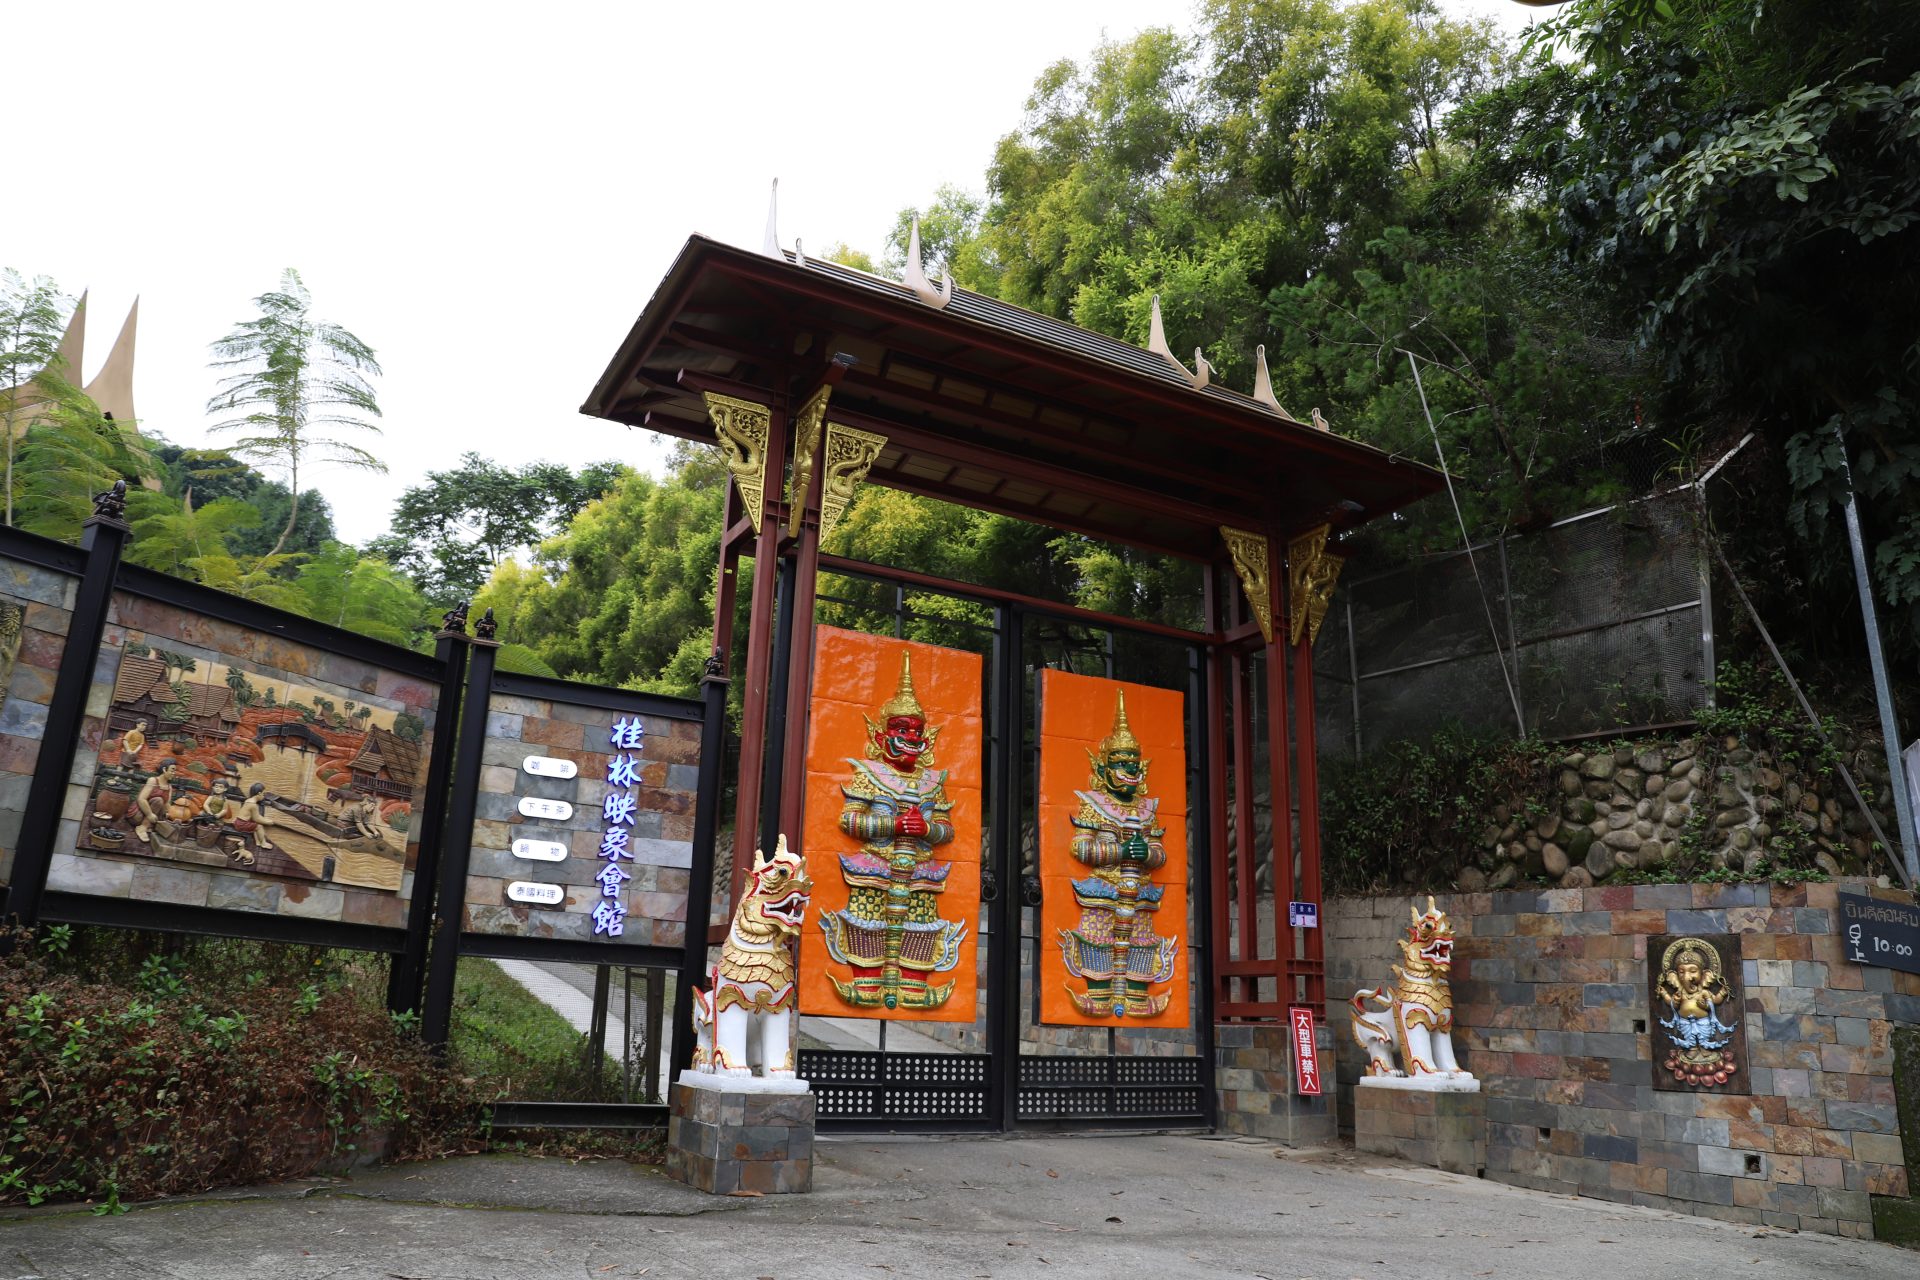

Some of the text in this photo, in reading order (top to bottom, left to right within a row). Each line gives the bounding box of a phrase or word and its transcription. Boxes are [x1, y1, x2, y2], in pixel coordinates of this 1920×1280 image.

[527, 802, 565, 815] 下午茶
[592, 716, 644, 937] 桂林映象會館
[516, 886, 556, 900] 泰國料理
[1873, 936, 1913, 956] 10:00
[1296, 1013, 1317, 1090] 大型車禁入
